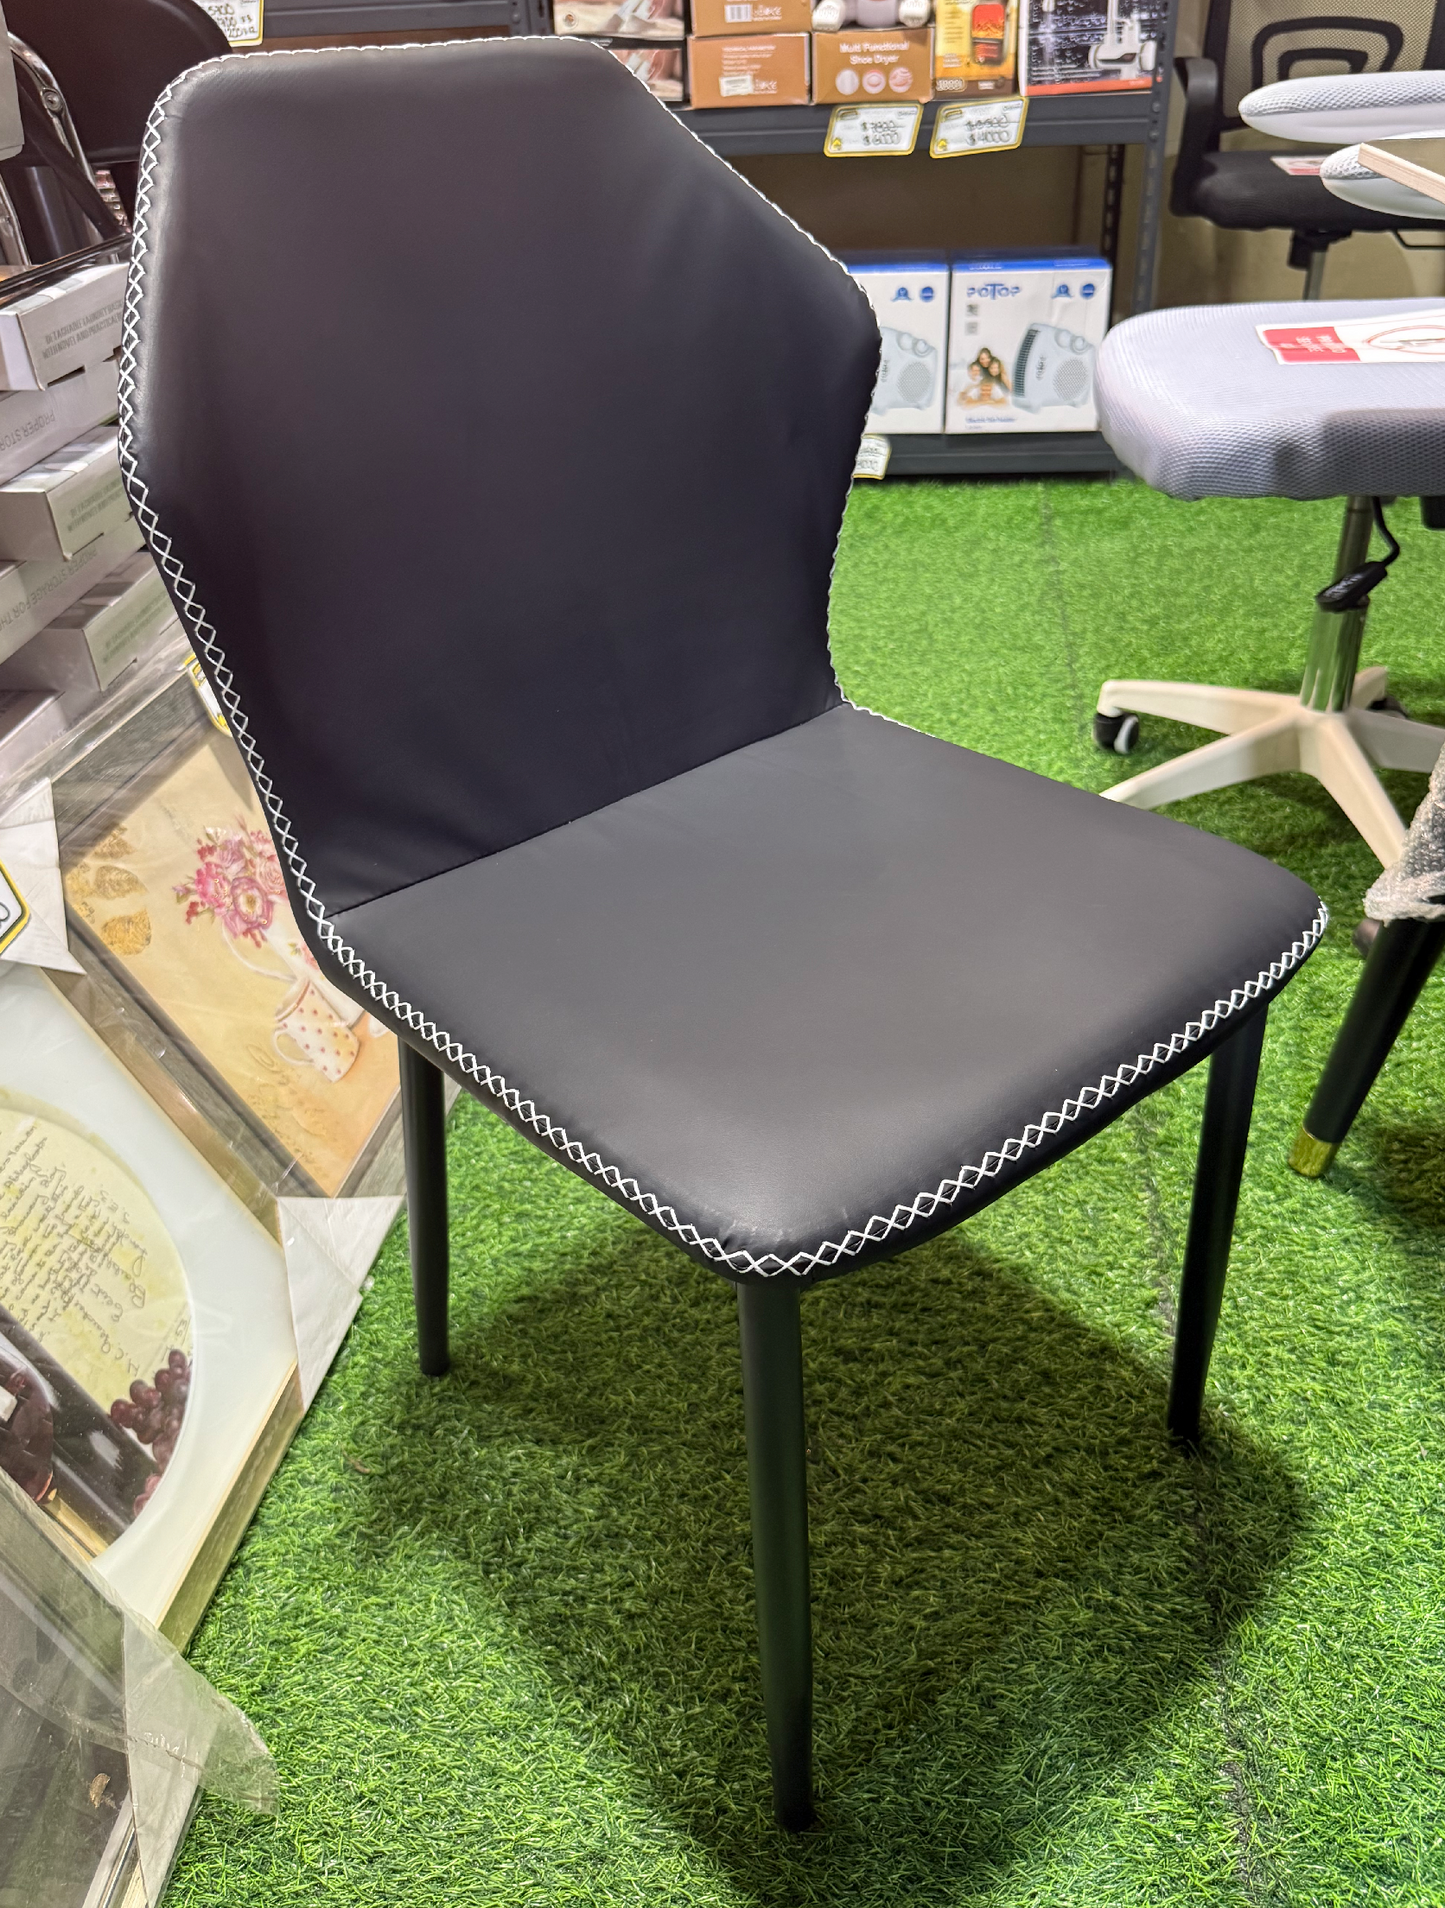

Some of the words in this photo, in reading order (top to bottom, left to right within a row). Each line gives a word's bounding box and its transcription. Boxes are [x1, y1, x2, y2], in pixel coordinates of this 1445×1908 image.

[862, 41, 909, 52] Functional
[850, 55, 873, 65] Shoe
[874, 54, 899, 65] Dryer
[21, 409, 56, 437] PROPER
[29, 569, 69, 604] STORAGE
[12, 597, 32, 618] FOR
